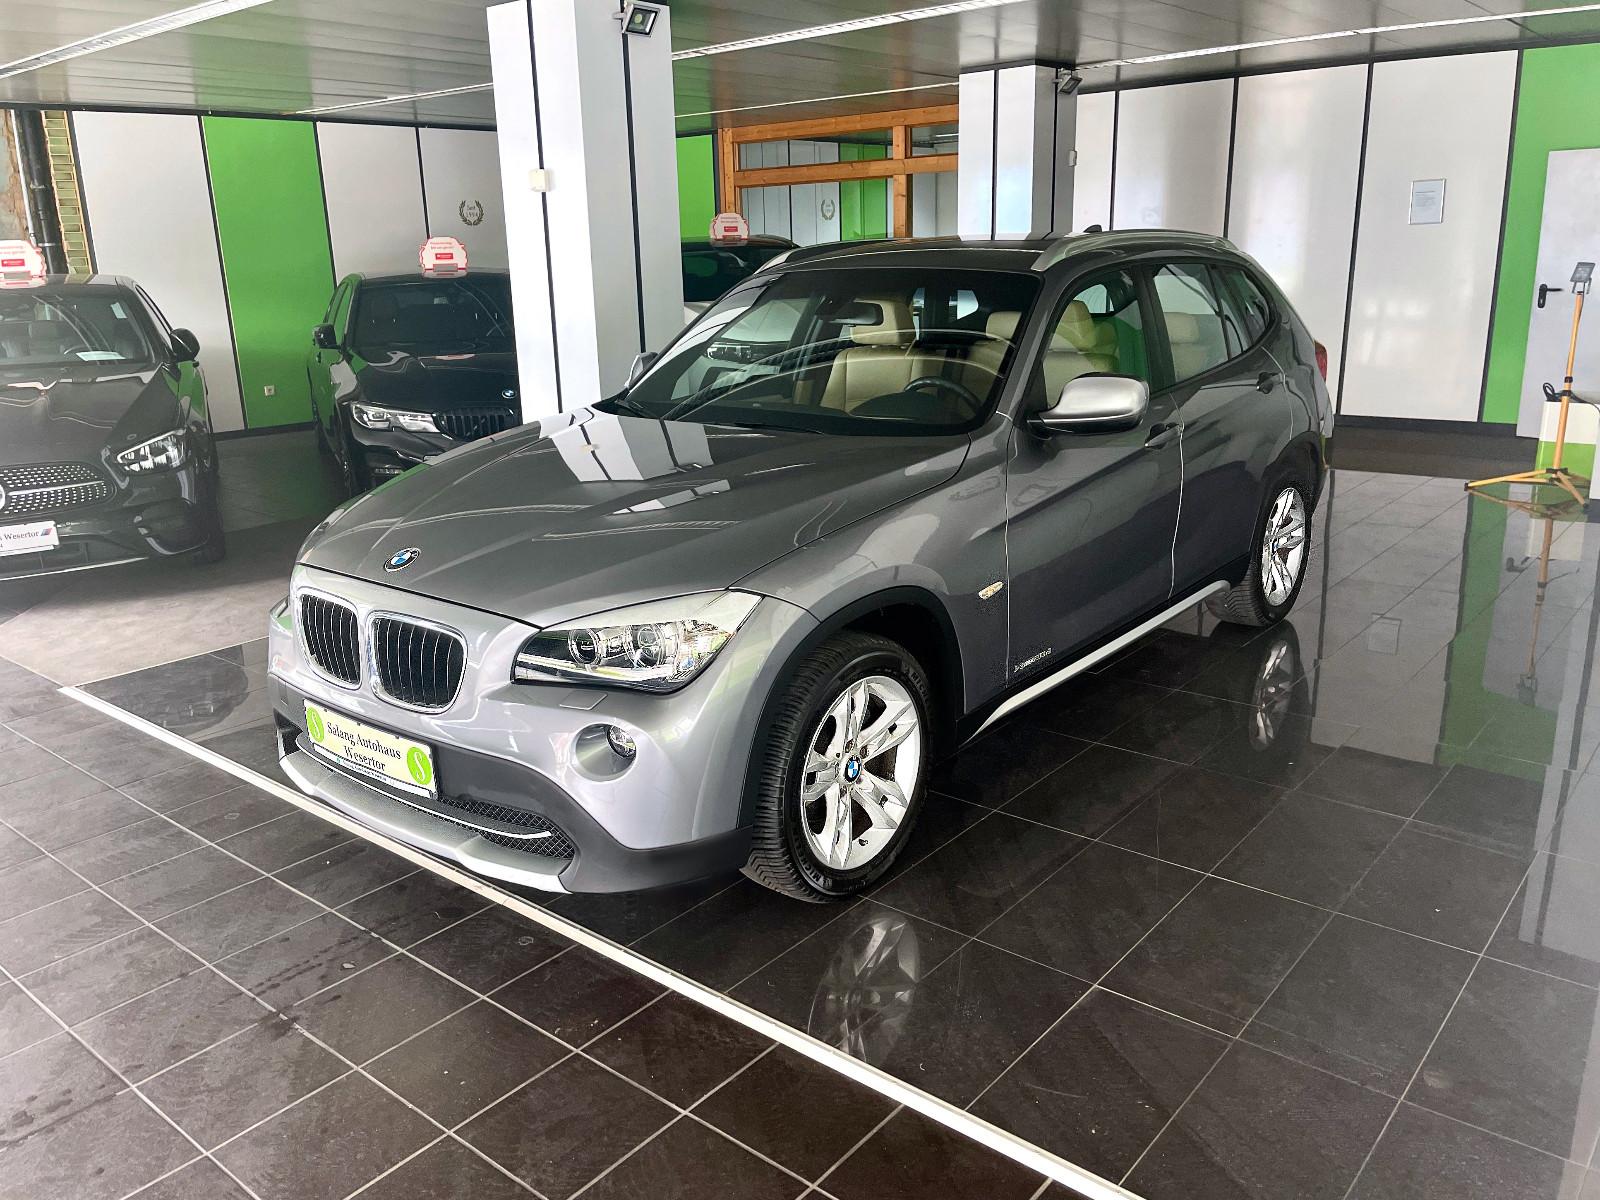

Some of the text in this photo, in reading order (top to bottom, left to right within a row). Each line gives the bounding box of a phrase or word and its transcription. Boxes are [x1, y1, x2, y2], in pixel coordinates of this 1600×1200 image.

[327, 721, 402, 760] Salang Autohaus
[343, 745, 386, 772] Wesertor
